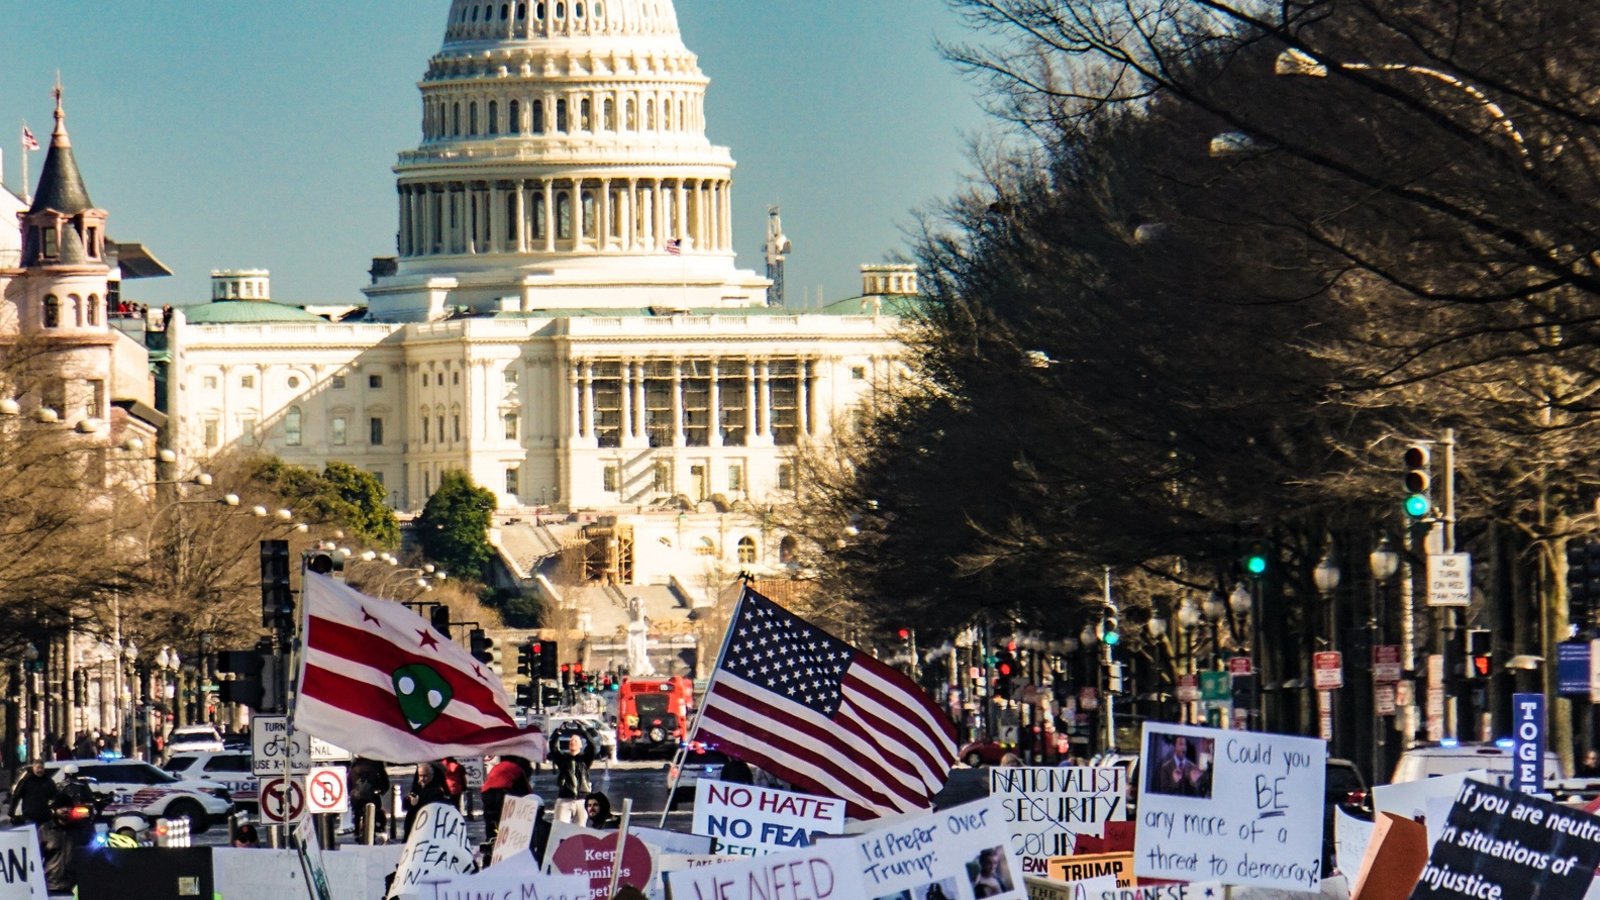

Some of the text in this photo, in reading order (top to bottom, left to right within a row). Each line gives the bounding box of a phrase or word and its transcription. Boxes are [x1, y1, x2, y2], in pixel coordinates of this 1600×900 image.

[1442, 559, 1456, 567] NO
[1433, 581, 1464, 589] ON RED
[255, 760, 270, 769] USE
[1227, 738, 1310, 775] Could you
[992, 769, 1125, 792] NATIONALIST
[1256, 775, 1289, 809] BE
[708, 784, 835, 820] NO HATE
[1002, 796, 1121, 823] SECURITY
[1469, 793, 1510, 815] you
[1511, 803, 1544, 825] are
[708, 815, 753, 839] NO
[861, 808, 989, 862] I'd Prefer Over
[1145, 811, 1175, 839] any
[1184, 814, 1228, 837] more
[1239, 820, 1264, 843] of
[1277, 827, 1288, 844] a
[412, 841, 460, 875] FEAR
[585, 849, 617, 862] Keep
[1146, 844, 1199, 872] threat
[1209, 853, 1228, 877] to
[1441, 821, 1578, 877] in situations of
[864, 851, 938, 884] Trump:
[1061, 861, 1123, 881] TRUMP
